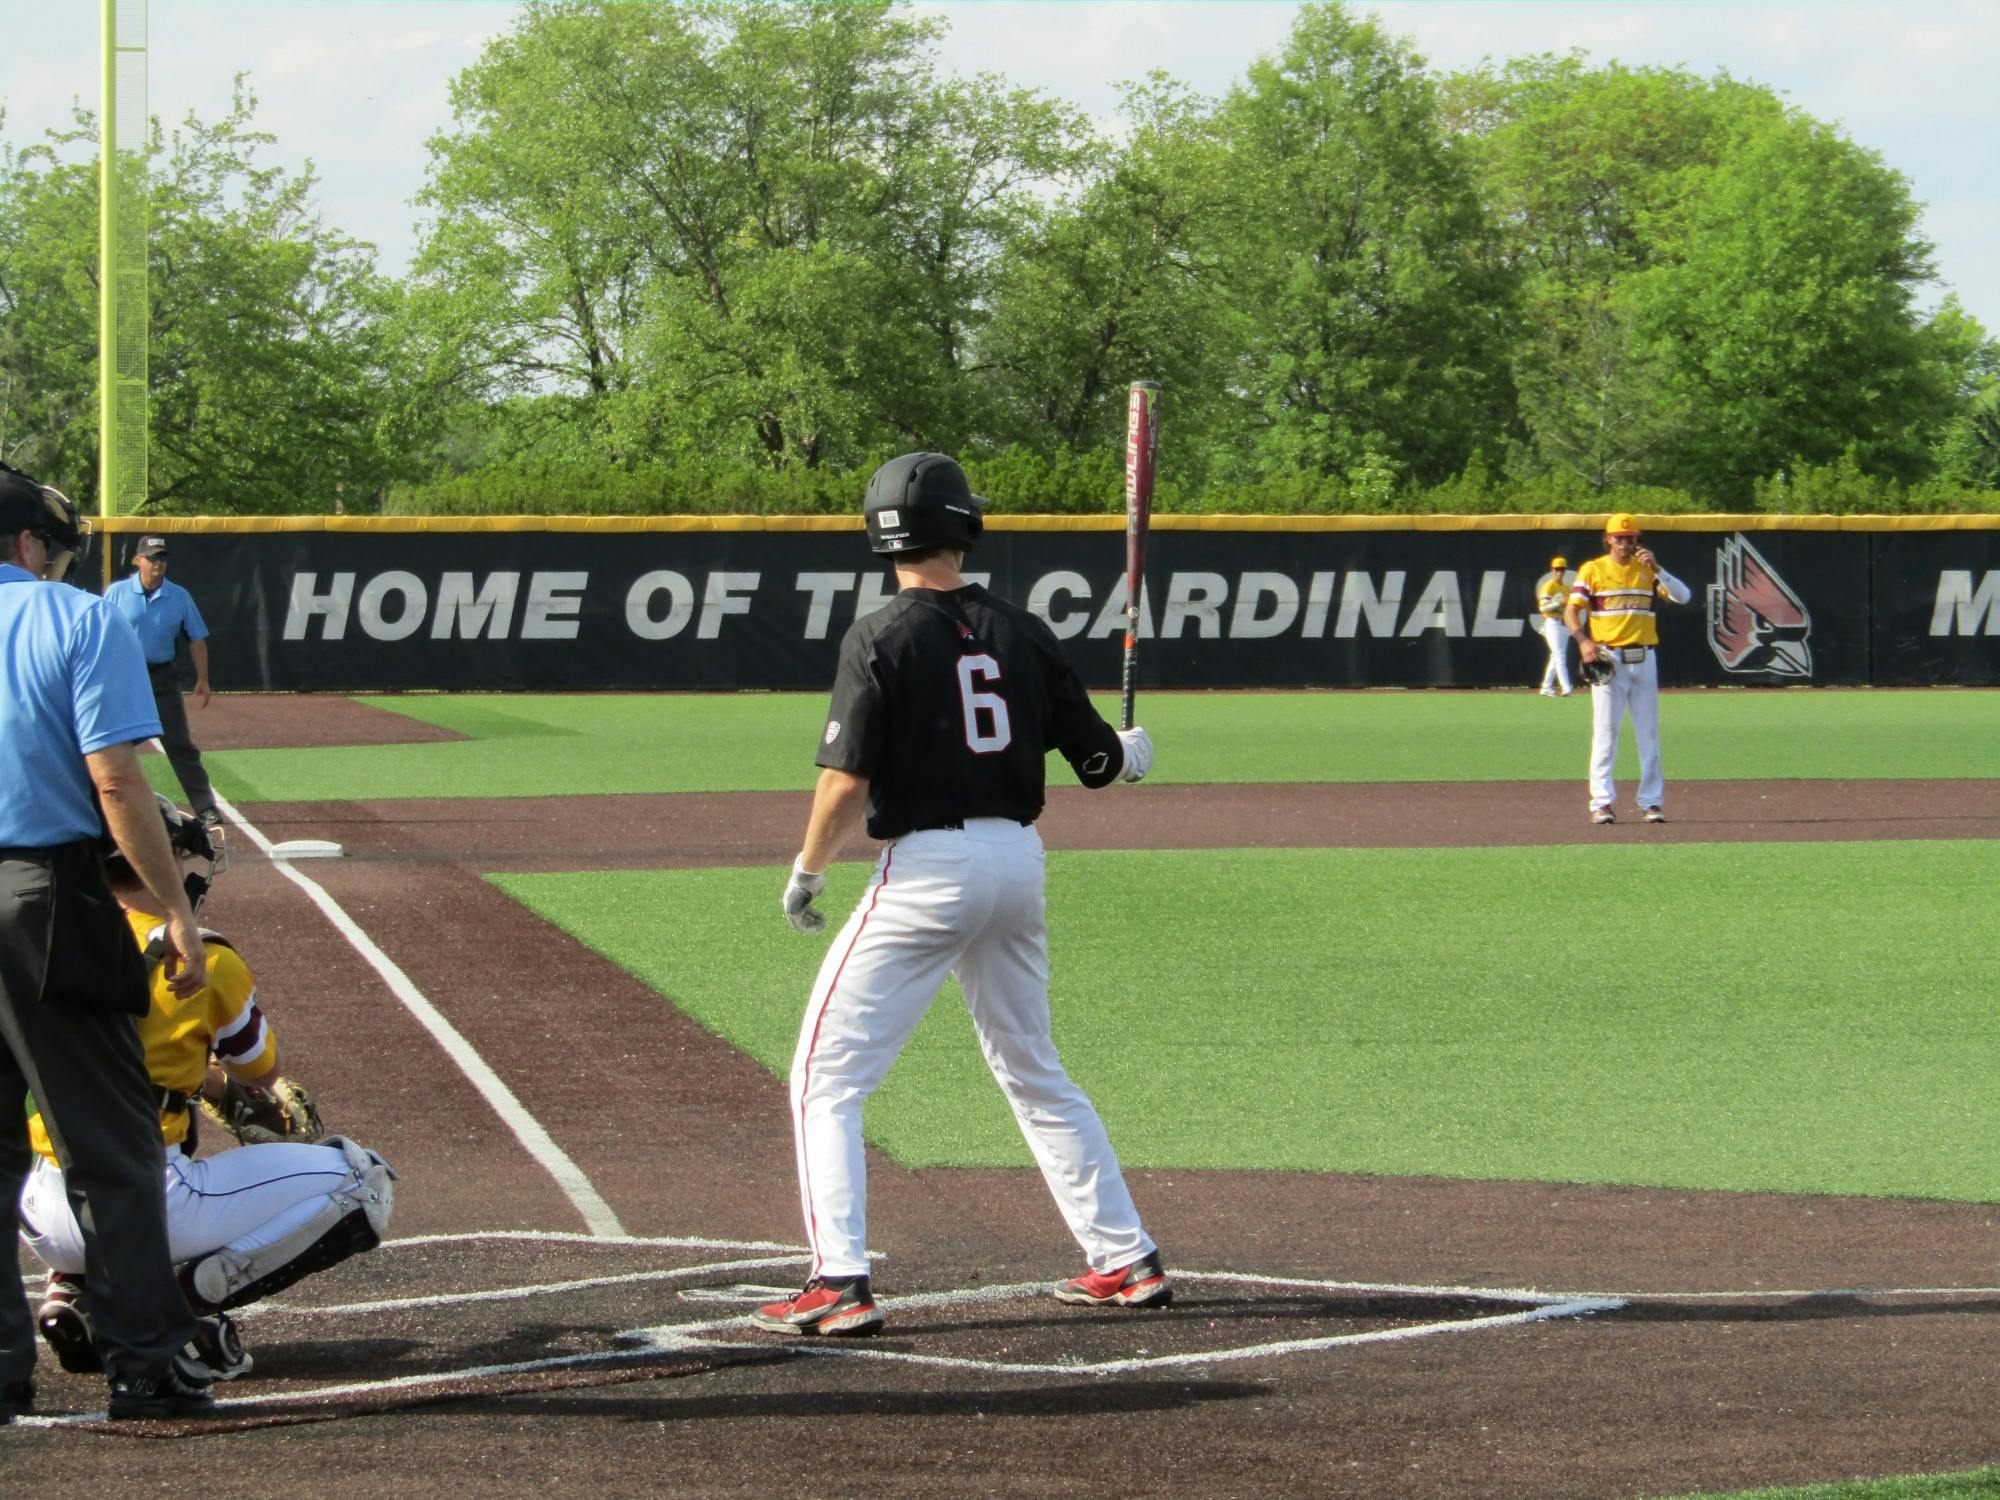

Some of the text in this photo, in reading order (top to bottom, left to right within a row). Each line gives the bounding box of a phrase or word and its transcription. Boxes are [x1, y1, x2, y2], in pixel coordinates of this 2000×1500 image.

[283, 571, 589, 641] HOME
[625, 570, 761, 640] OF
[957, 653, 1012, 753] 6
